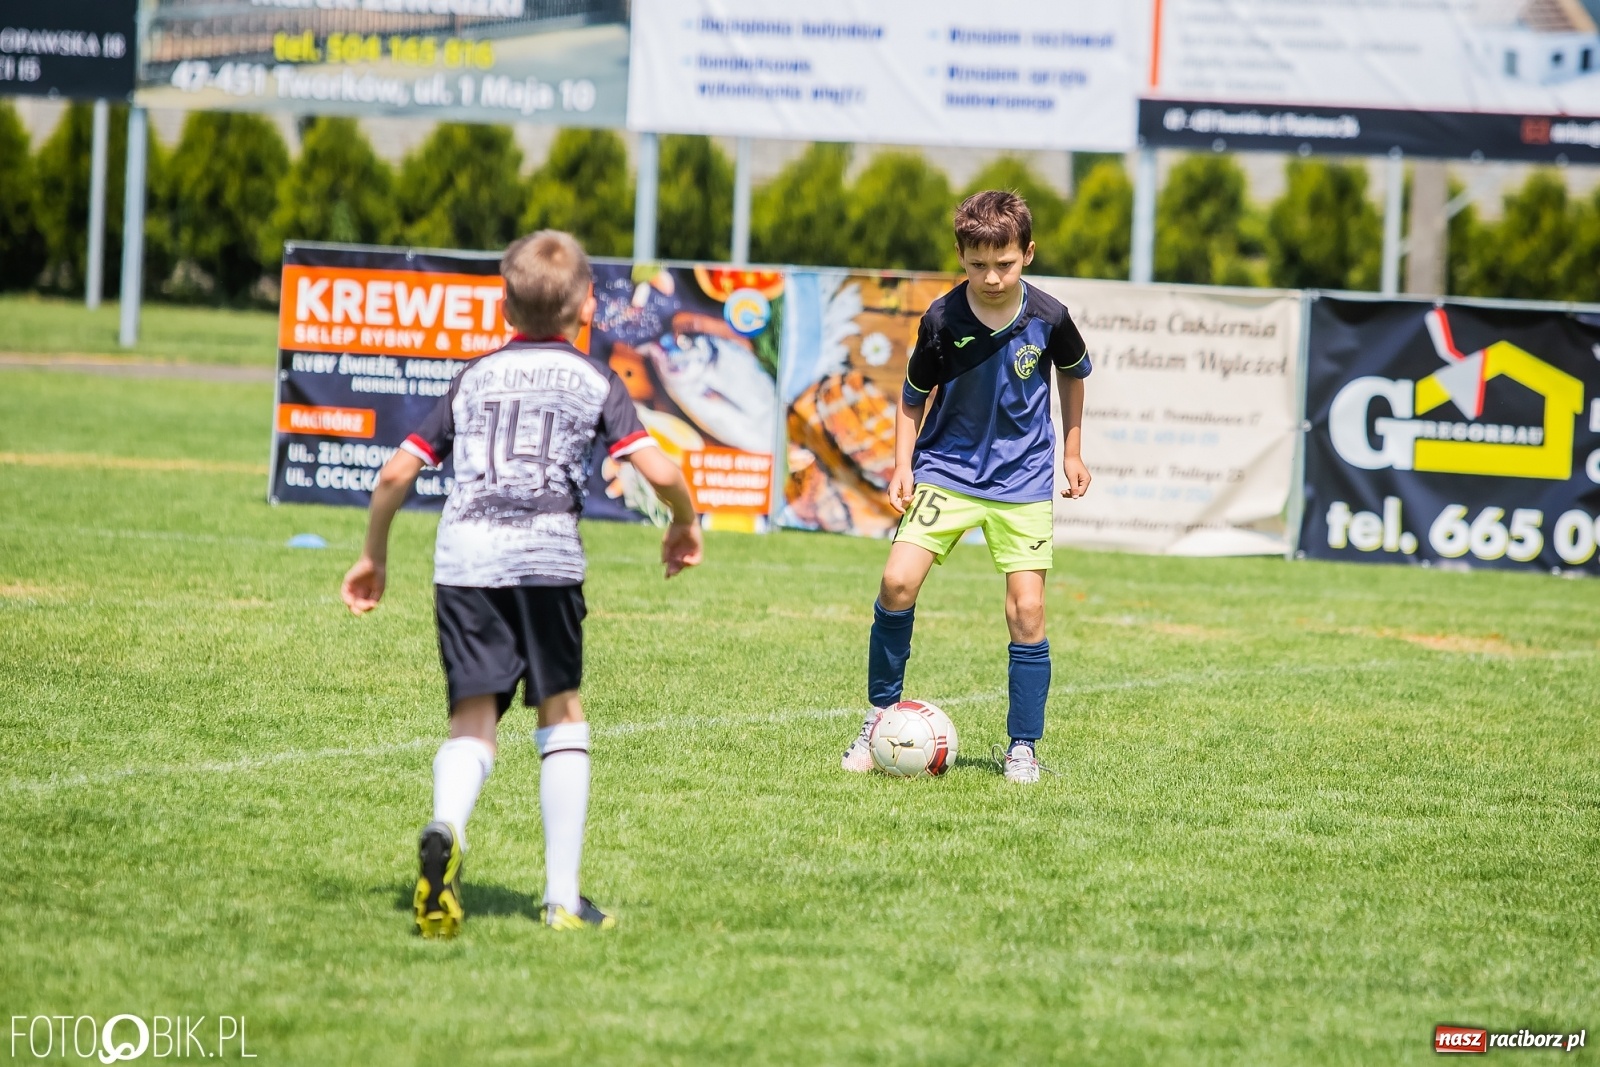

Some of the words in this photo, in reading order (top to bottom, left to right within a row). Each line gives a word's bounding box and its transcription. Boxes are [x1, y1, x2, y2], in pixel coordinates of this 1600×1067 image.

[273, 29, 320, 62] tel.
[414, 73, 453, 105] ul.
[458, 74, 475, 106] 1
[480, 74, 554, 115] Maja
[559, 78, 597, 112] 10
[296, 276, 514, 333] KREWET
[294, 322, 356, 346] SKLEP
[360, 327, 425, 349] RYBNY
[436, 331, 451, 351] &
[292, 353, 338, 374] RYBY
[503, 368, 582, 391] UNITED
[479, 397, 561, 492] 14
[909, 489, 947, 527] 15
[1326, 496, 1418, 555] tel.
[1428, 503, 1544, 562] 665
[1553, 508, 1600, 565] 0
